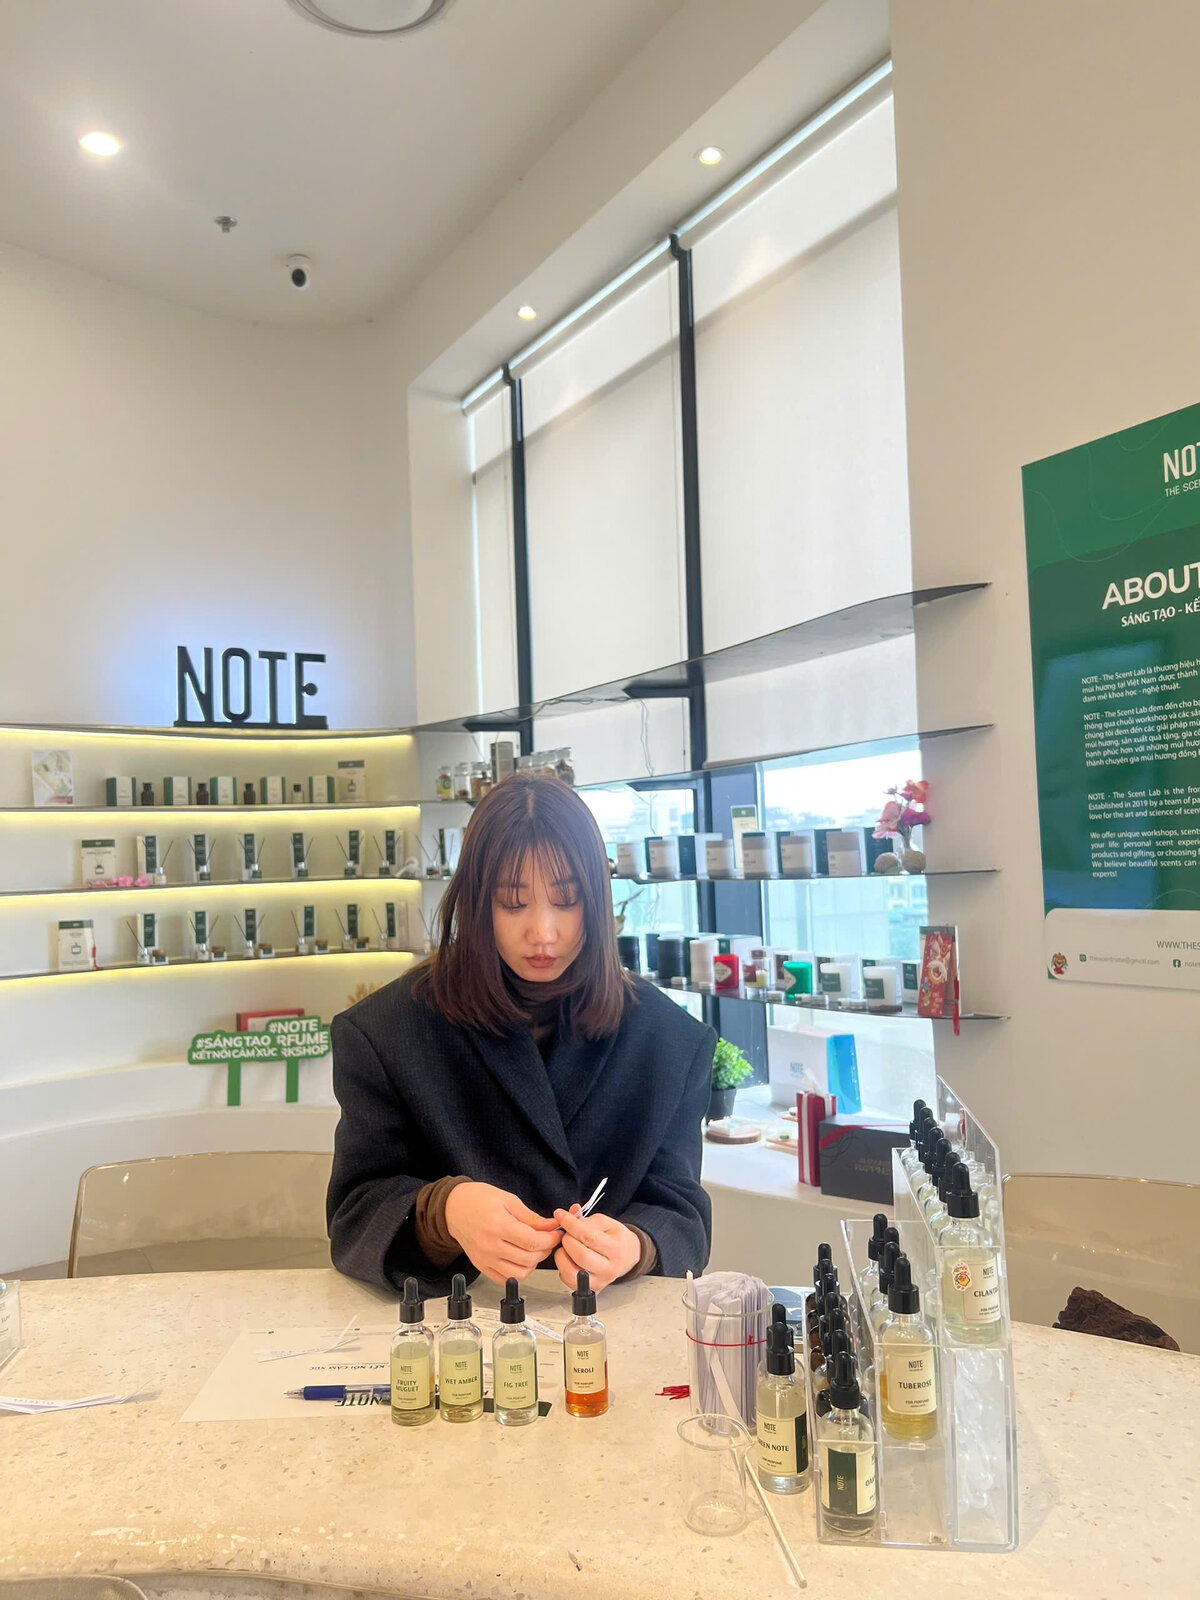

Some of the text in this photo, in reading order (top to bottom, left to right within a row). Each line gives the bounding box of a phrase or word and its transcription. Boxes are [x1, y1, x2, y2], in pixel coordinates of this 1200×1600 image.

[1163, 442, 1200, 483] NO
[1164, 479, 1200, 497] THE SCE
[1102, 562, 1200, 610] ABOUT
[1121, 612, 1150, 627] SÁNG
[1152, 606, 1176, 622] TẠO
[1081, 676, 1098, 684] NOTE
[1102, 674, 1114, 682] The
[1115, 671, 1133, 680] Scent
[1133, 668, 1146, 676] Lab
[1140, 676, 1157, 684] Nam
[176, 646, 327, 729] NOTE
[1083, 712, 1100, 721] NOTE
[1104, 710, 1116, 719] The
[1117, 708, 1135, 717] Scent
[1136, 706, 1148, 714] Lab
[1135, 713, 1168, 724] workshop
[1088, 792, 1105, 801] NOTE
[1112, 791, 1124, 799] The
[1127, 790, 1146, 798] Scent
[1148, 788, 1162, 796] Lab
[1164, 788, 1170, 796] is
[1172, 786, 1184, 794] the
[1088, 802, 1124, 811] Established
[1132, 799, 1148, 808] 2019
[1149, 798, 1158, 808] by
[1164, 797, 1182, 806] team
[1183, 796, 1191, 804] of
[1088, 812, 1102, 820] love
[1102, 810, 1112, 819] for
[1113, 810, 1124, 818] the
[1124, 809, 1134, 818] art
[1134, 808, 1148, 817] and
[1148, 806, 1174, 816] science
[1174, 806, 1182, 815] of
[1117, 831, 1140, 840] unique
[1140, 828, 1179, 838] workshops,
[1090, 842, 1105, 850] your
[1124, 839, 1152, 848] personal
[1091, 850, 1119, 860] products
[1120, 850, 1132, 858] and
[1165, 848, 1197, 858] choosing
[1092, 860, 1102, 868] We
[1104, 860, 1126, 868] believe
[1128, 858, 1158, 868] beautiful
[1160, 860, 1182, 868] scents
[1092, 870, 1118, 880] experts!
[268, 1018, 318, 1034] #NOTE
[276, 1031, 329, 1047] RFUME
[576, 1350, 589, 1358] NOTE
[908, 1360, 924, 1369] NOTE
[458, 1376, 478, 1384] AMBER
[515, 1380, 528, 1388] TREE
[898, 1378, 932, 1390] TUBEROSE
[764, 1422, 776, 1432] NOTE
[772, 1444, 789, 1452] NOTE
[836, 1474, 845, 1490] NOTE
